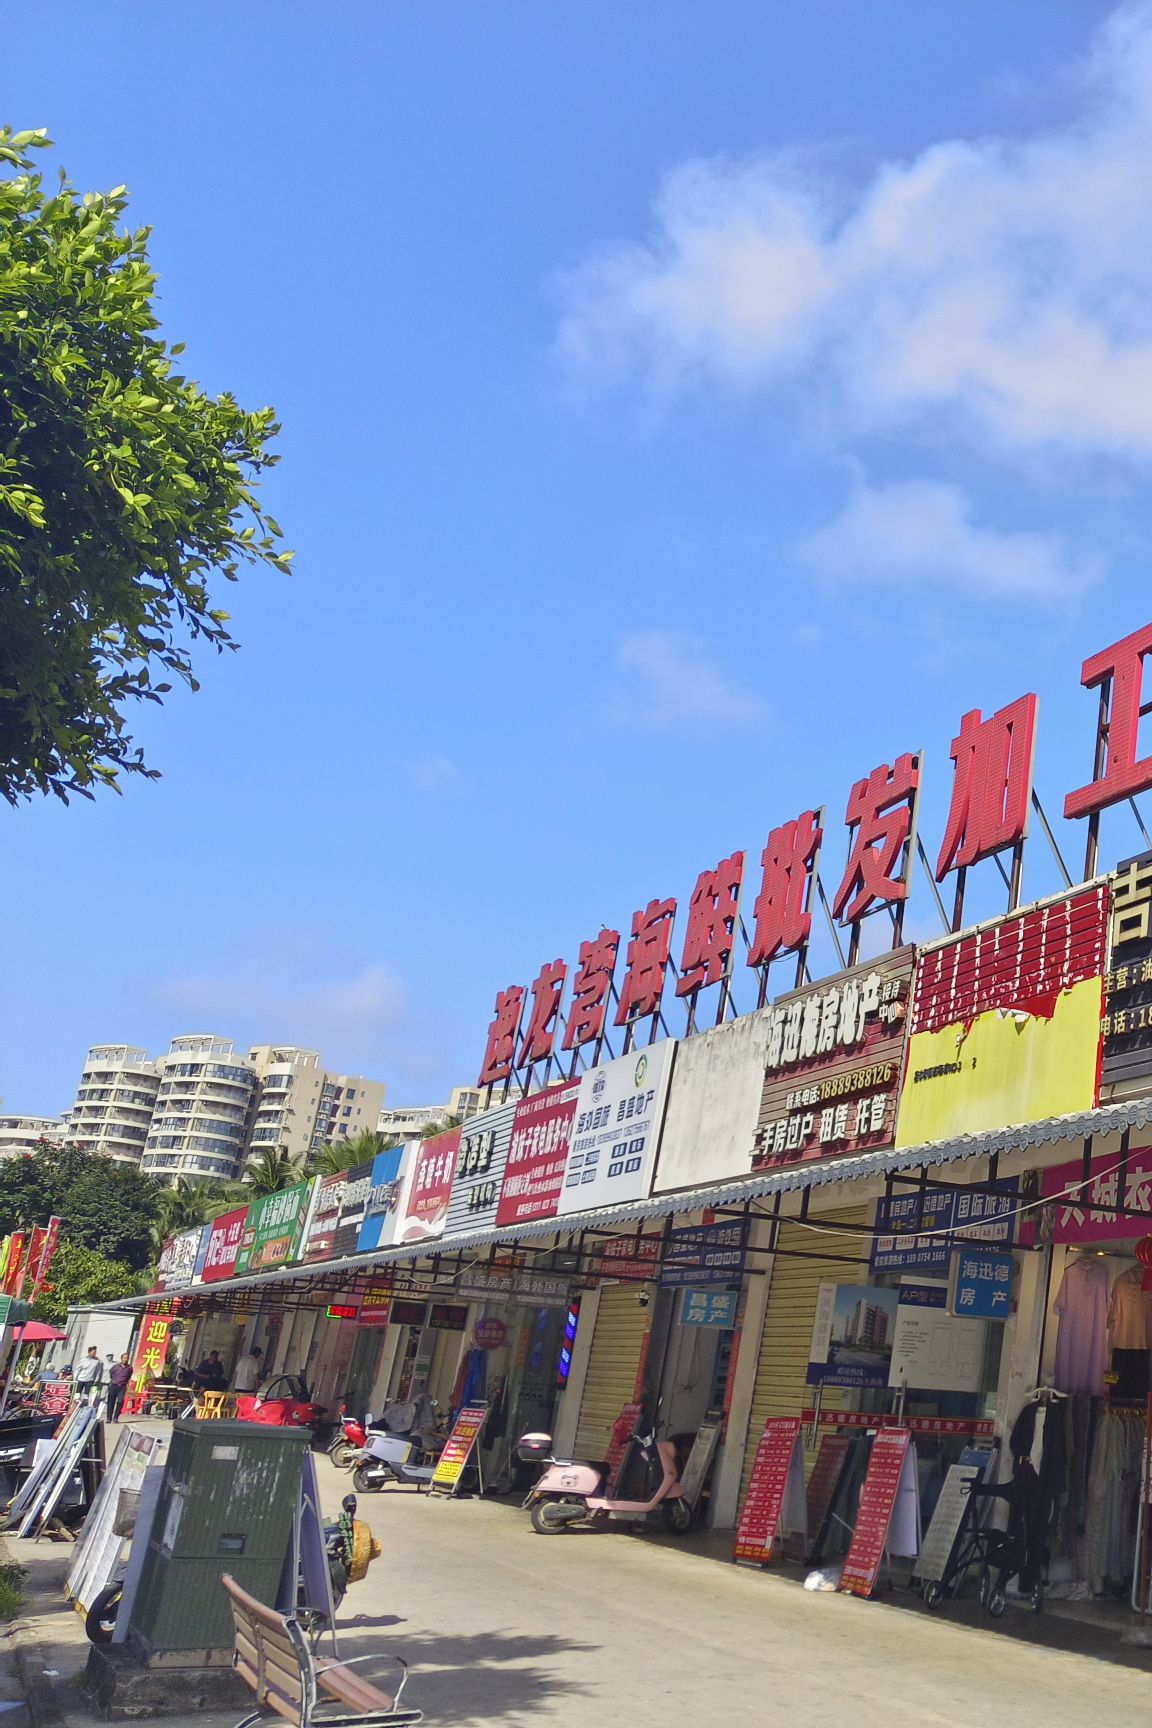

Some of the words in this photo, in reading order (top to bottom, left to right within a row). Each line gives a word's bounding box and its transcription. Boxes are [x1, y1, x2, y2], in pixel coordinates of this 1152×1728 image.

[855, 1094, 887, 1135] 托管
[962, 1260, 1009, 1282] 海迅德
[960, 1288, 1008, 1307] 房产
[818, 1412, 880, 1425] 迅德房地产
